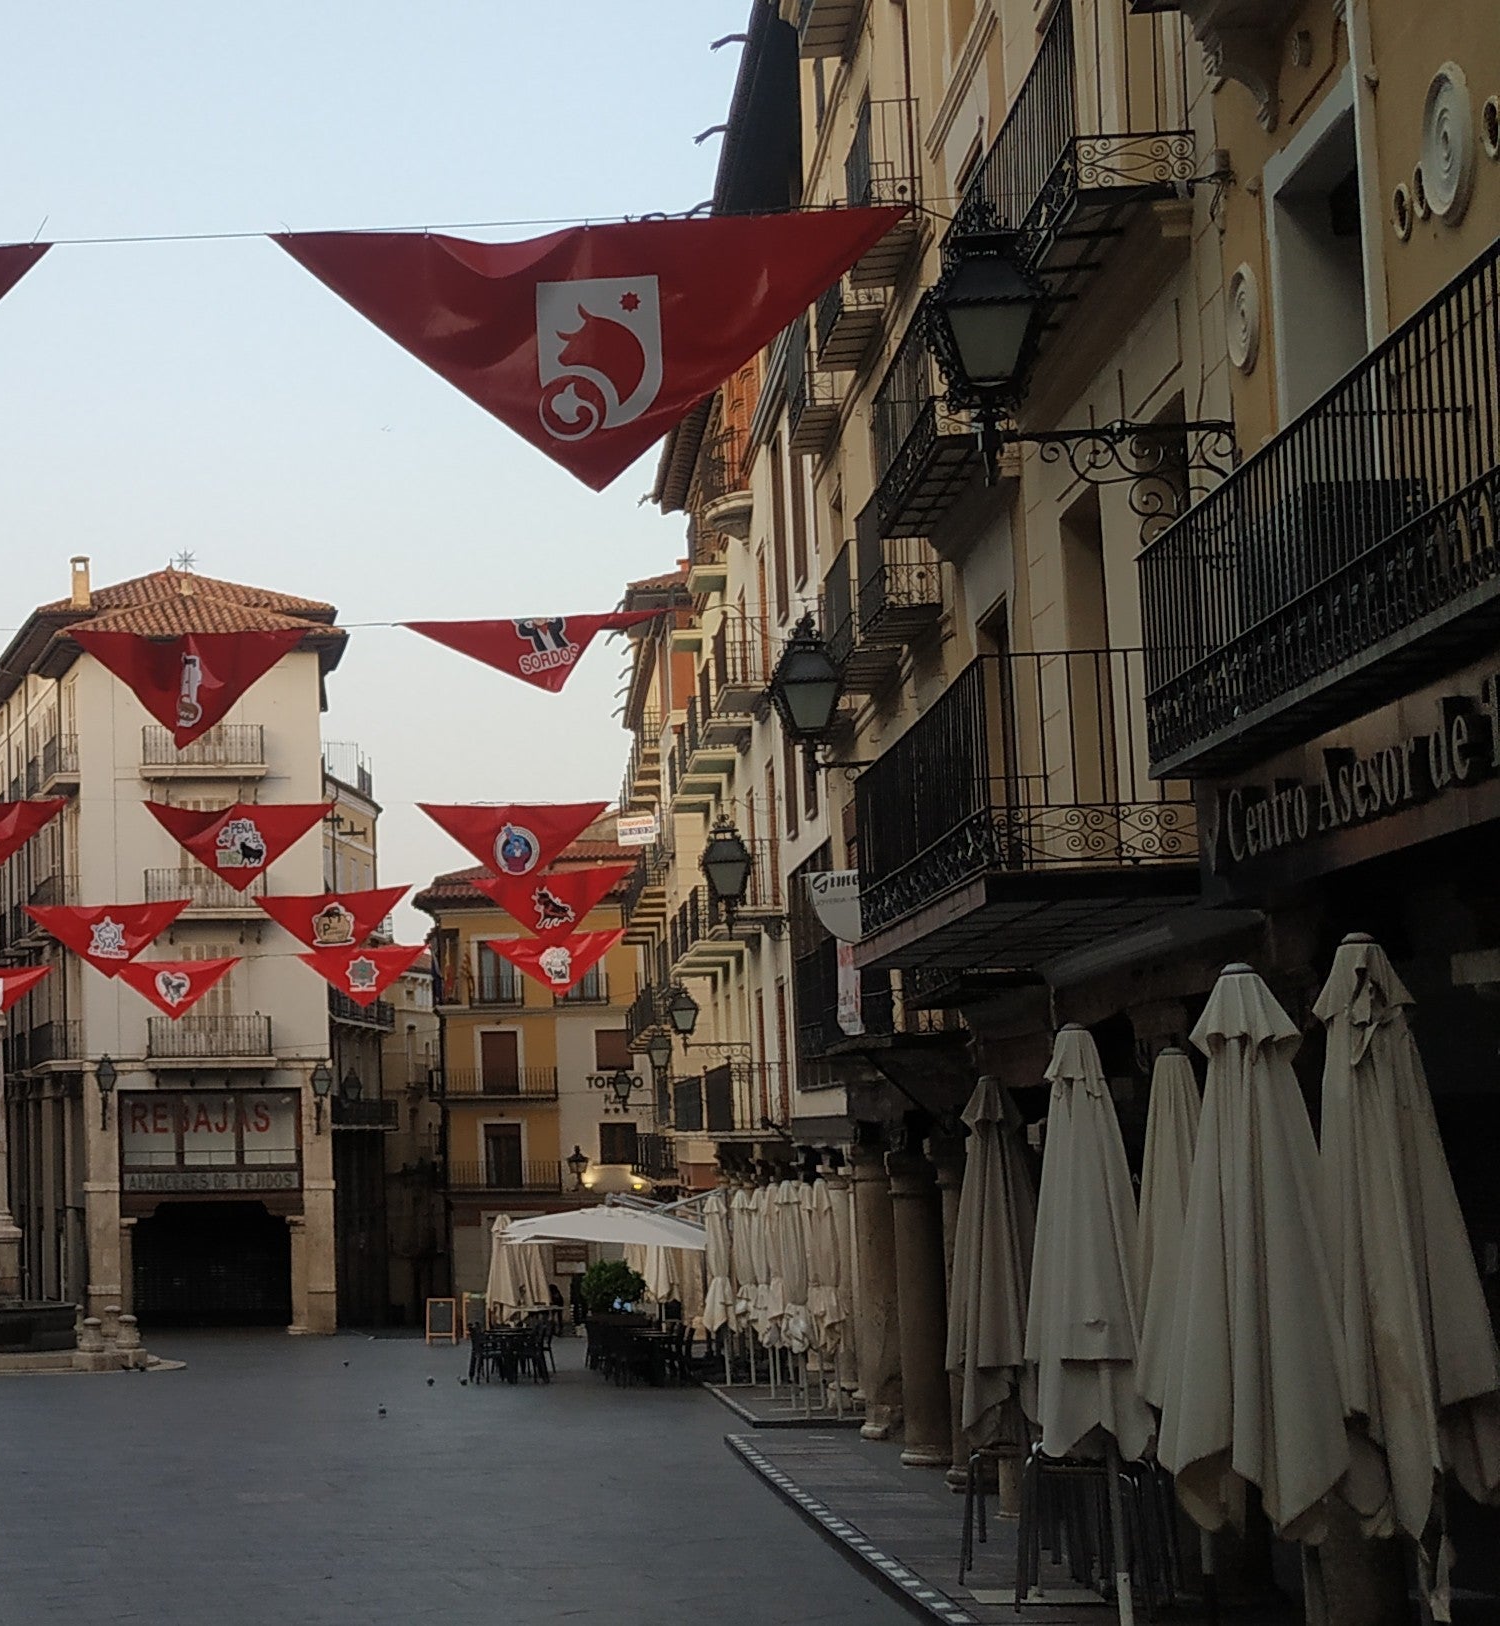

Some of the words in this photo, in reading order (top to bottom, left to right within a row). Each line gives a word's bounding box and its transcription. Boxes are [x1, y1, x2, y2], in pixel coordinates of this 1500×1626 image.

[521, 645, 578, 672] SORDOS
[1227, 781, 1308, 862] Centro
[1318, 737, 1416, 831] Asesor
[1429, 696, 1470, 789] de
[585, 1076, 644, 1088] TORO
[129, 1173, 208, 1189] ALMACENES
[214, 1174, 227, 1187] DE
[236, 1173, 293, 1187] TEJIDOS
